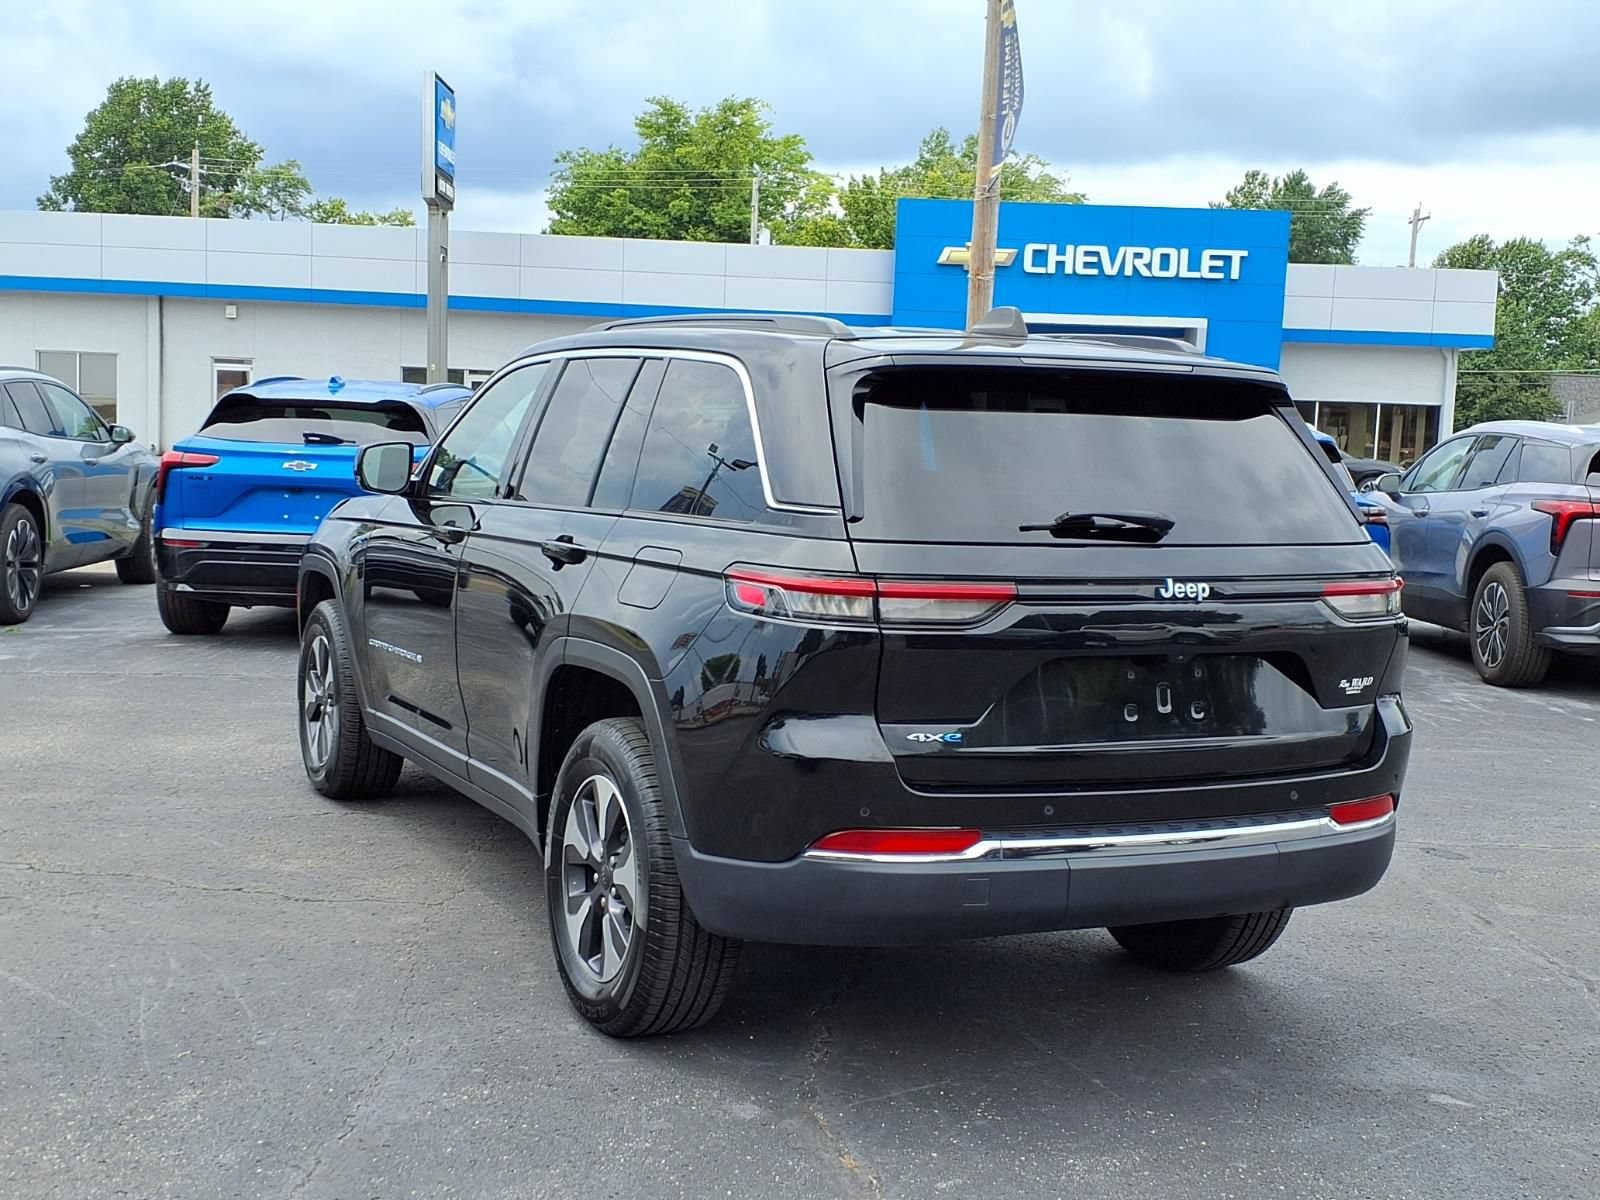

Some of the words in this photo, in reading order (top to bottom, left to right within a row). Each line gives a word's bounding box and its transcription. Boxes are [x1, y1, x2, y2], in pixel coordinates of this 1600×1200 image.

[1002, 34, 1012, 116] LIFETIME
[1023, 242, 1249, 280] CHEVROLET
[1159, 577, 1210, 601] Jeep
